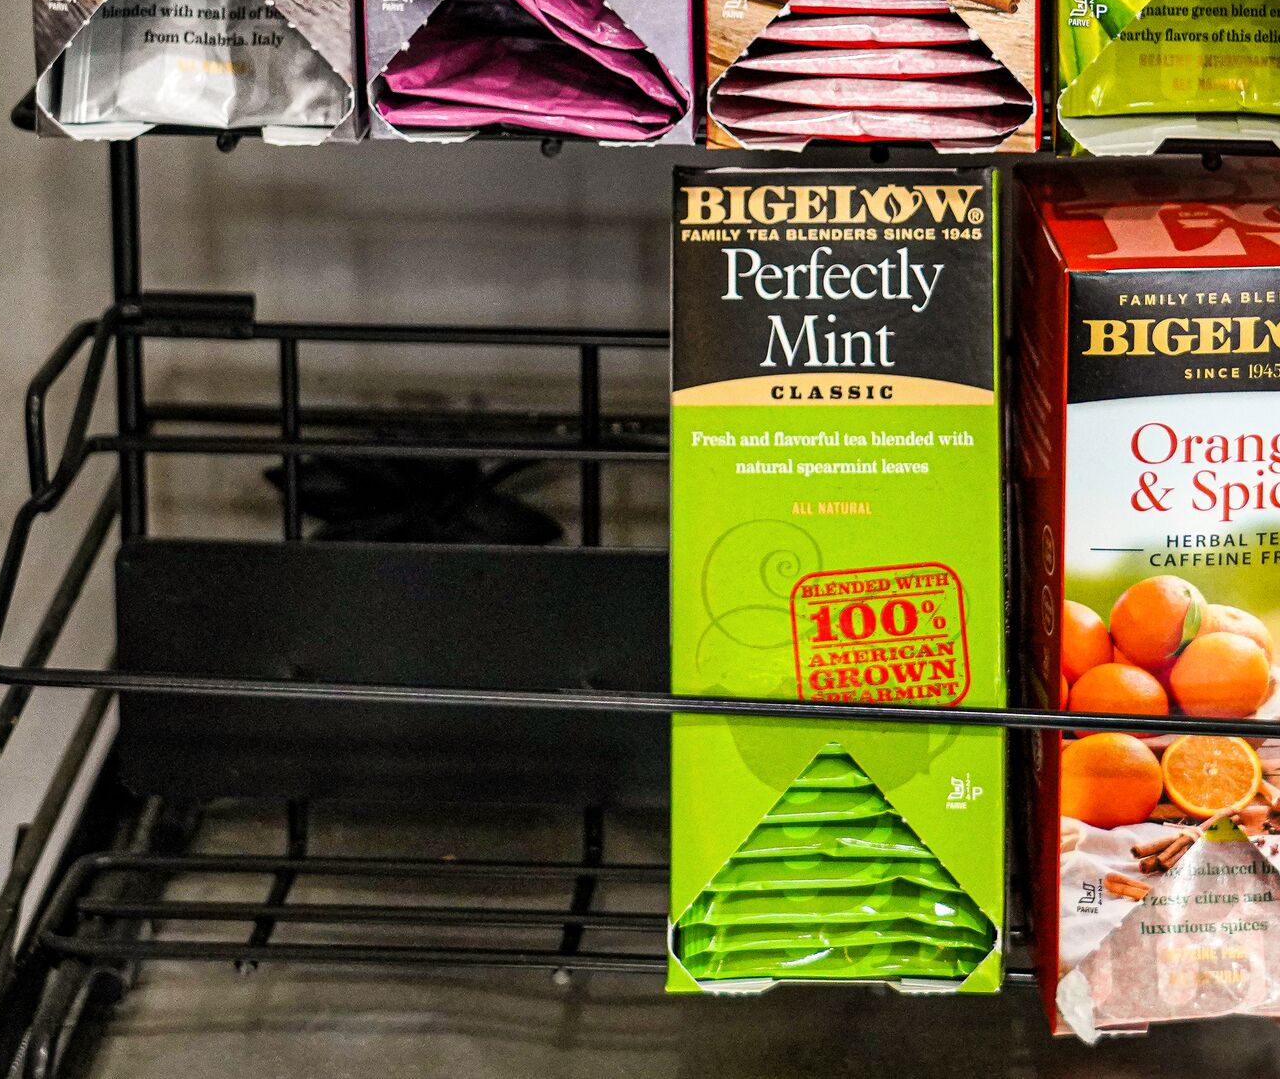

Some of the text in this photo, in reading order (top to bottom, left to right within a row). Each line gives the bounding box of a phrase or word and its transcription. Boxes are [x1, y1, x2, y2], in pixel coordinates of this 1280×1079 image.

[102, 5, 156, 19] blended
[160, 5, 193, 18] with
[197, 7, 226, 20] real
[229, 7, 246, 20] oil
[249, 6, 262, 19] of
[1141, 5, 1188, 19] gnature
[1191, 6, 1228, 19] green
[1231, 4, 1266, 17] blend
[1068, 18, 1089, 27] PARVE
[144, 29, 179, 43] from
[252, 32, 283, 48] Italy
[1120, 28, 1161, 44] earthy
[1165, 28, 1208, 42] flavors
[1212, 29, 1225, 41] of
[1226, 29, 1251, 42] this
[682, 228, 982, 241] FAMILY TEA BLENDERS SINCE 1945
[722, 247, 944, 312] Perfectly
[1120, 294, 1187, 305] FAMILY
[1196, 293, 1232, 305] TEA
[760, 314, 895, 366] Mint
[1185, 368, 1239, 379] SINCE
[771, 386, 892, 399] CLASSIC
[692, 431, 974, 446] Fresh and flavorful tea blended with
[736, 459, 928, 477] natural spearmint leaves
[1131, 472, 1171, 512] &
[792, 502, 871, 515] ALL NATURAL
[1167, 534, 1248, 549] HERBAL
[1150, 552, 1251, 566] CAFFEINE
[800, 573, 950, 598] BLENDED WITH
[810, 599, 947, 643] 100%
[808, 642, 955, 667] AMERICAN
[809, 658, 956, 690] GROWN
[1195, 890, 1239, 904] citrus
[1243, 891, 1273, 903] and
[1140, 918, 1269, 935] luxurious spices
